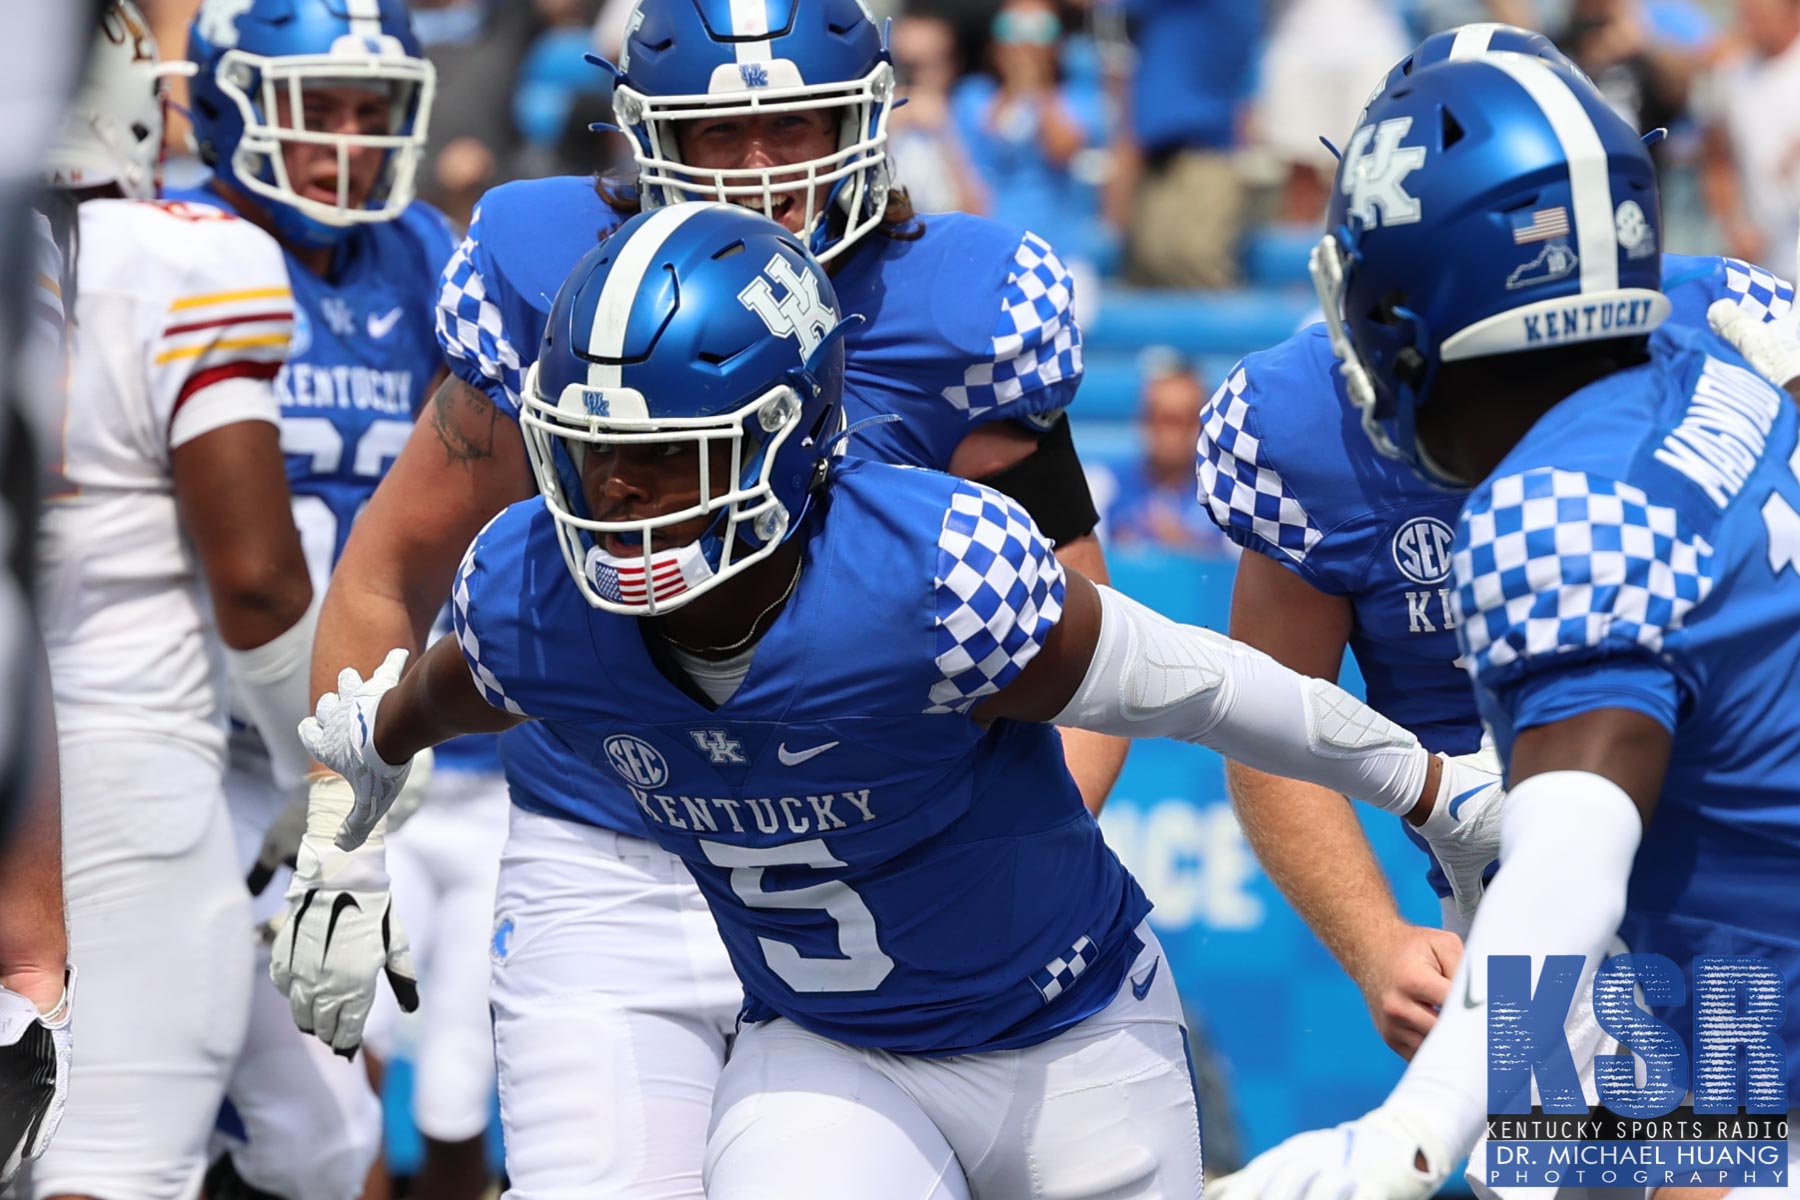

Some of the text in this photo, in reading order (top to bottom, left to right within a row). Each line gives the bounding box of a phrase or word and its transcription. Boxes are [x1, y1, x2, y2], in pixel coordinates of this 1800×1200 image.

[1524, 299, 1652, 342] KENTUCKY
[273, 361, 412, 414] KENTUCKY
[1398, 523, 1453, 579] SEC
[609, 738, 663, 785] SEC
[627, 783, 877, 834] KENTUCKY
[698, 838, 895, 992] 5
